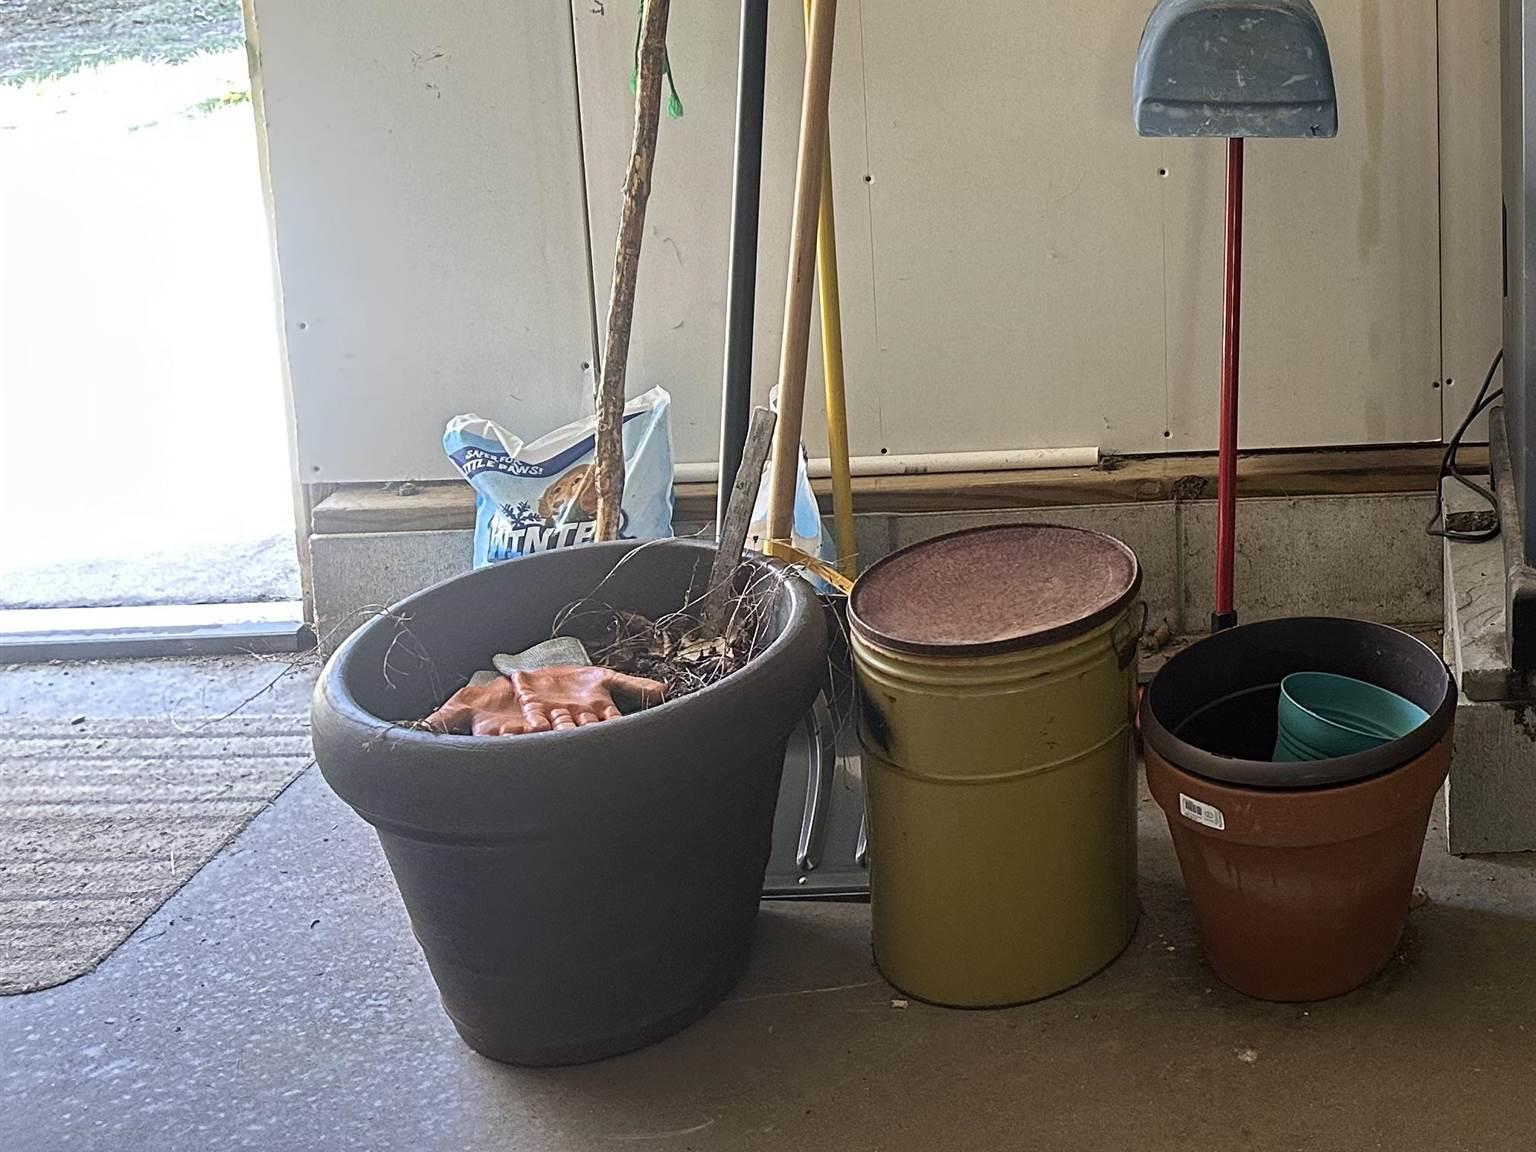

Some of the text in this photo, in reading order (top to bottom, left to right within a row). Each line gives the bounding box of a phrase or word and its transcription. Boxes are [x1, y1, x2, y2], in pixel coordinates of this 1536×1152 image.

[465, 449, 498, 463] SAFER
[463, 459, 544, 476] ITTLE PAWS!
